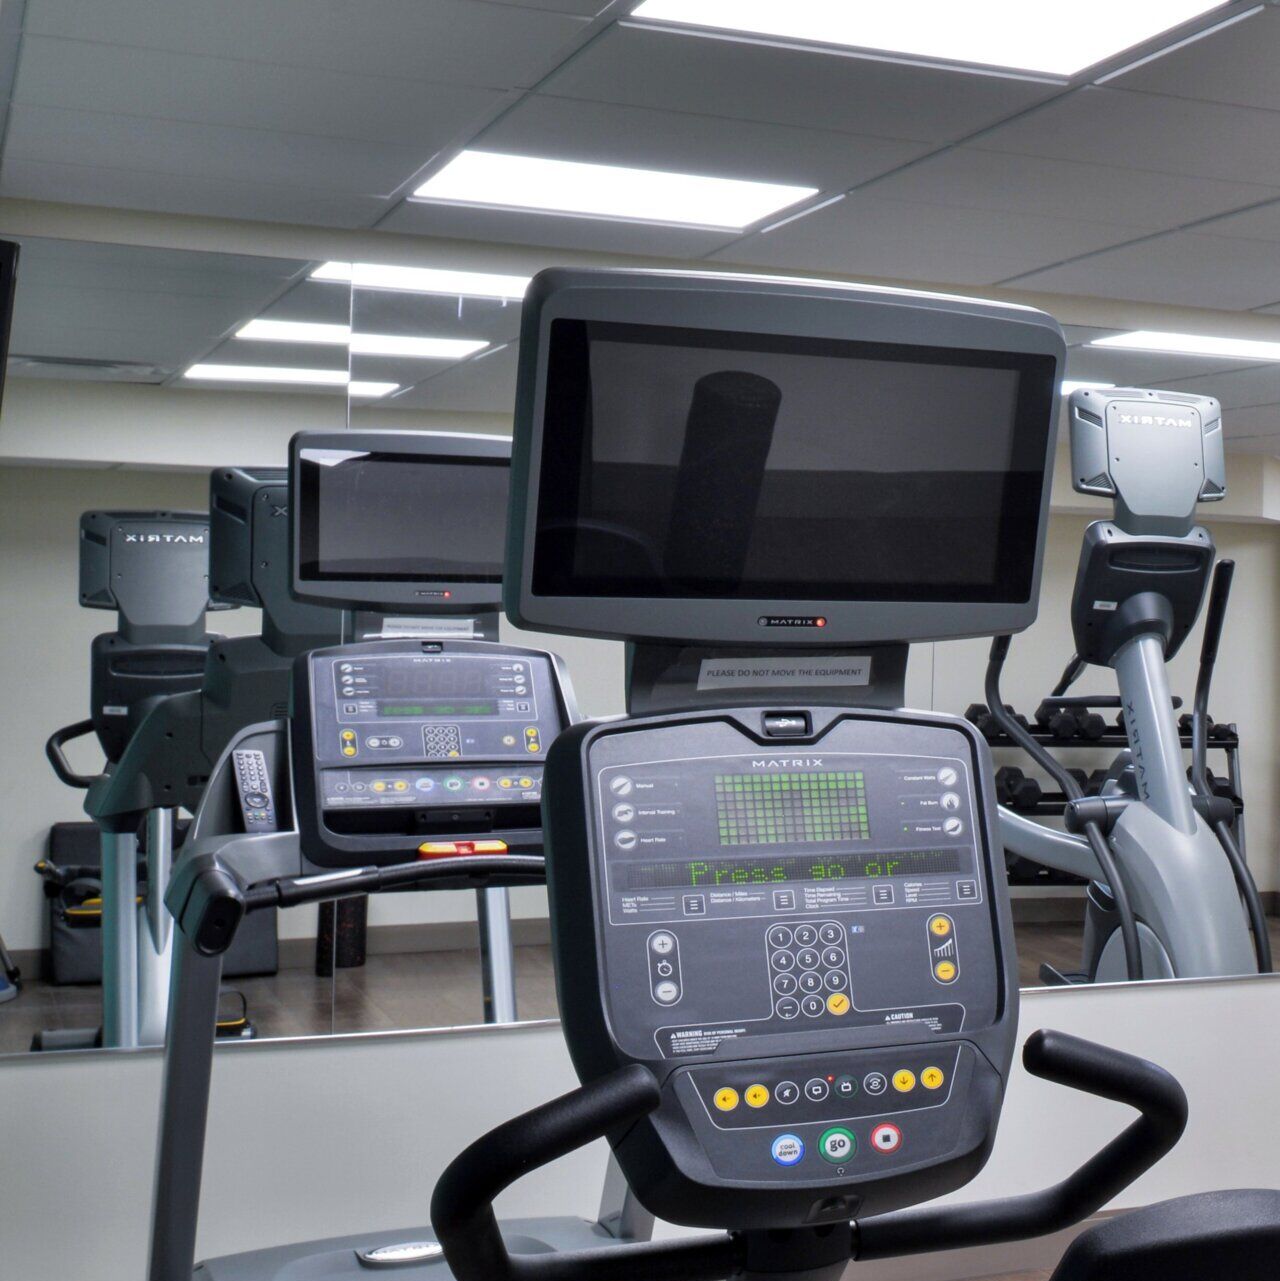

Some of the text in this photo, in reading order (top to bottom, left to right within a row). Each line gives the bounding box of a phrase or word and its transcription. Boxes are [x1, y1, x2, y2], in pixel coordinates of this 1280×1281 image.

[737, 669, 750, 677] DO
[752, 669, 770, 677] NOT
[814, 668, 863, 676] EQUIPMENT
[752, 759, 823, 768] MATRIX
[690, 862, 787, 887] Press
[865, 861, 899, 879] or
[778, 929, 835, 942] 1 2 3
[780, 952, 837, 965] 4 5 6
[782, 976, 839, 989] 7 8 9
[809, 1001, 817, 1010] 0
[890, 1012, 914, 1020] CAUTION
[675, 1029, 703, 1039] WARNING
[829, 1138, 846, 1152] go
